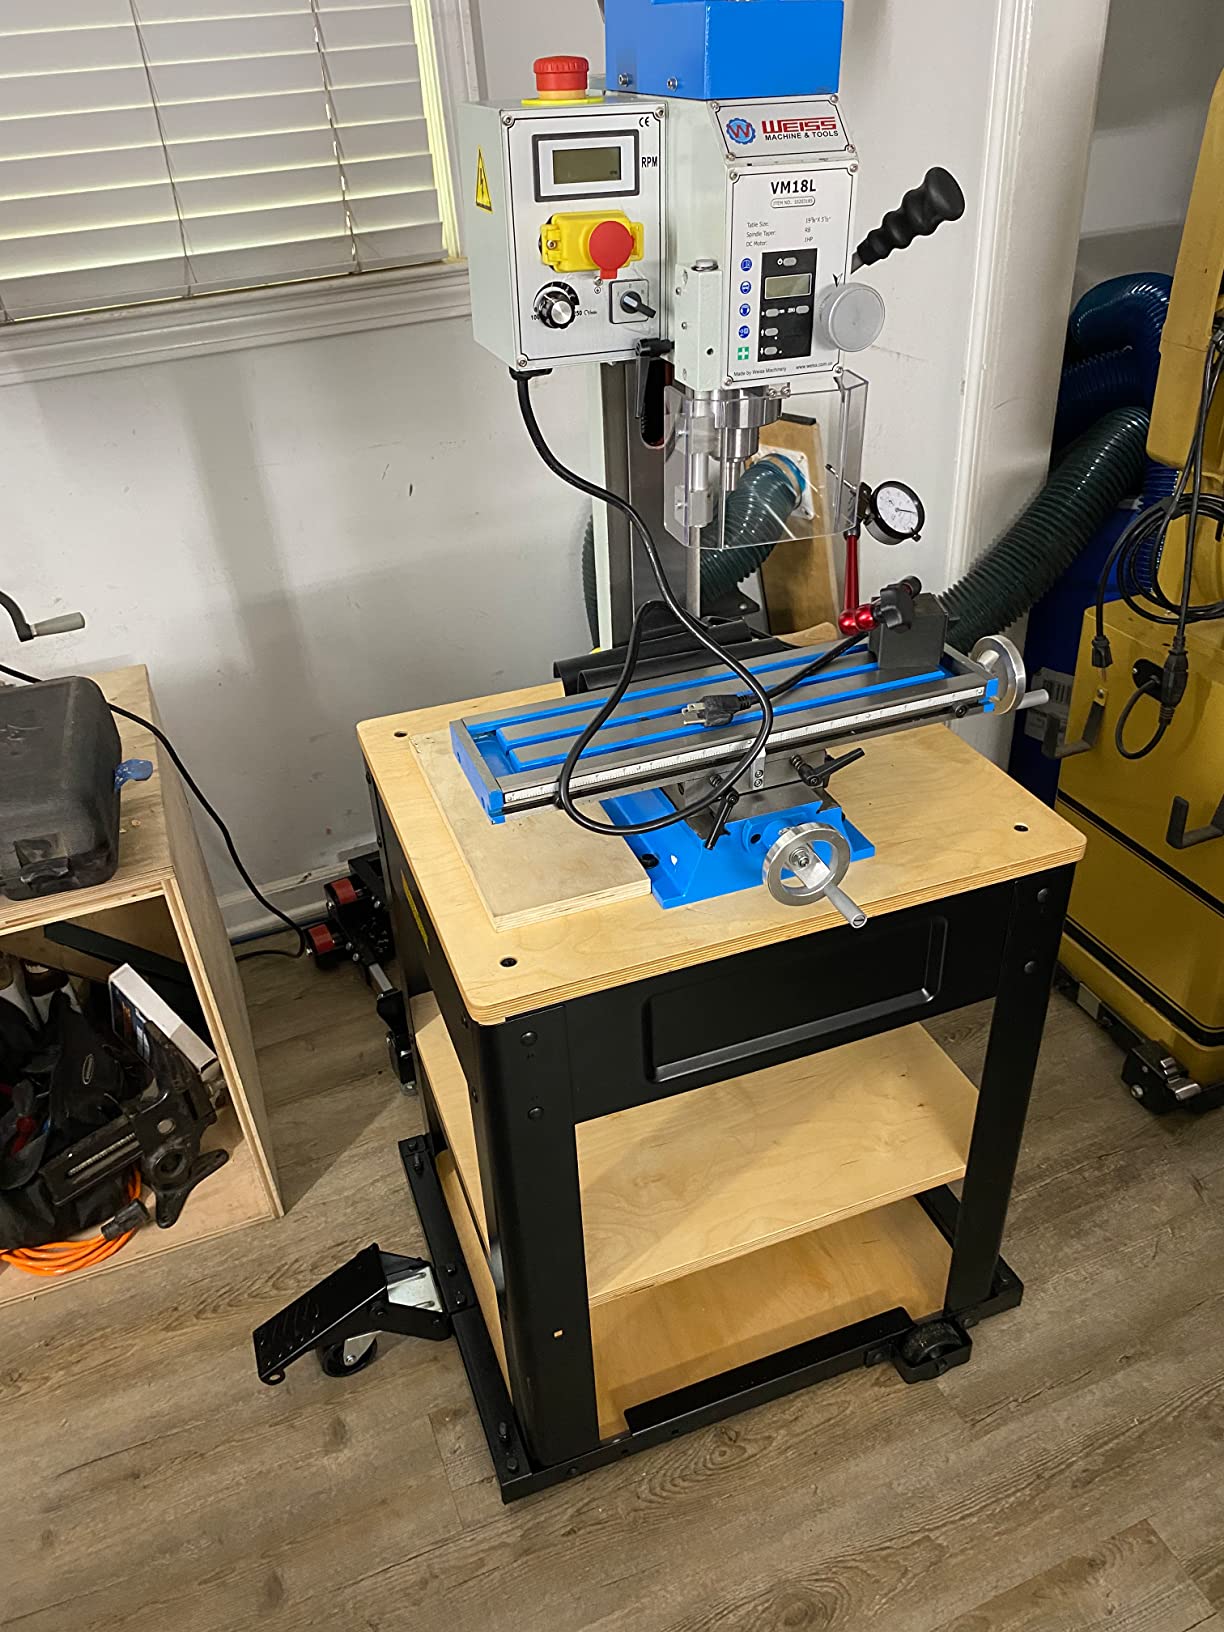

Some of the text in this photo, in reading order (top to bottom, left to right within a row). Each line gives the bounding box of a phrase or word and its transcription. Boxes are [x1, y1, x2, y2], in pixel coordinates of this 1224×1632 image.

[638, 116, 650, 128] CE
[761, 117, 837, 134] WEISS
[765, 132, 802, 141] MACHINE
[812, 130, 839, 138] TOOLS
[641, 156, 658, 169] RPM
[770, 179, 817, 195] VM18L
